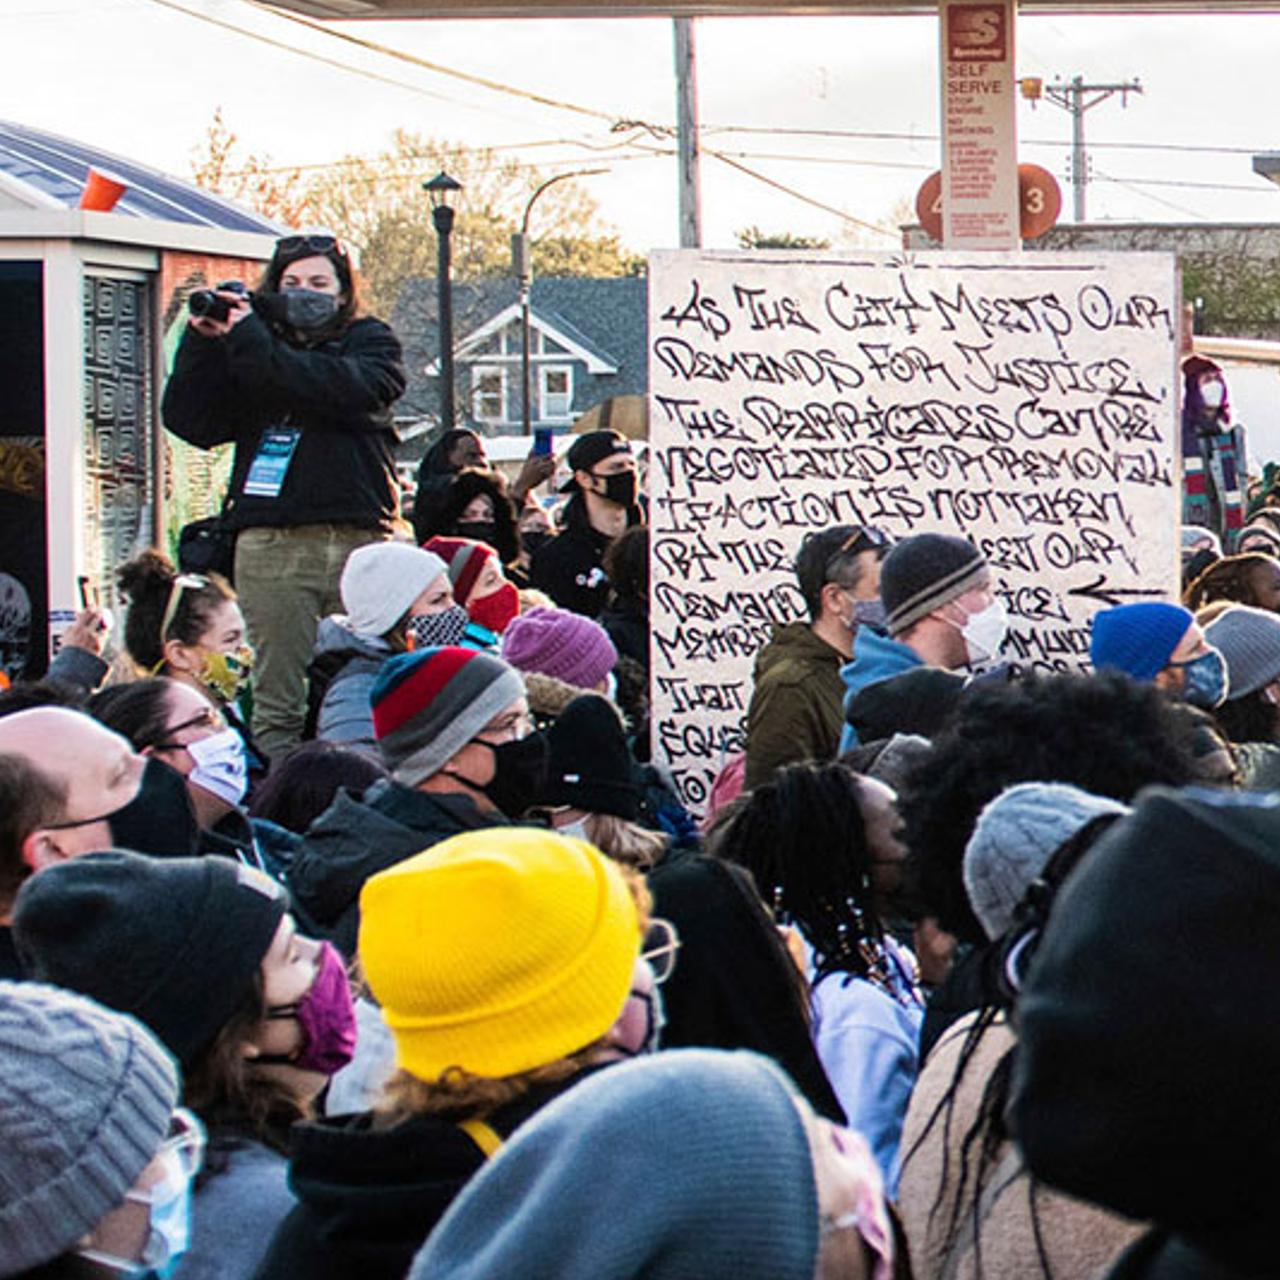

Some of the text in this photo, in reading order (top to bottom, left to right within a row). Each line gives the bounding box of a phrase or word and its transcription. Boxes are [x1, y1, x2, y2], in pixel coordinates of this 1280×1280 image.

[947, 64, 989, 77] SELF
[947, 80, 1002, 93] SERVE
[1026, 188, 1044, 213] 3
[660, 273, 1174, 348] AS THE CITY MEETS OUR
[654, 337, 865, 393] DEMANDS
[858, 342, 961, 391] FOR
[655, 395, 757, 444] THE
[743, 396, 1014, 444] BARRICADES
[1101, 399, 1163, 443] BE
[896, 445, 992, 483] FOR
[656, 491, 713, 533] IF
[860, 485, 924, 529] IS
[653, 527, 1139, 582] BY THE EET OUR
[656, 676, 744, 713] THAT
